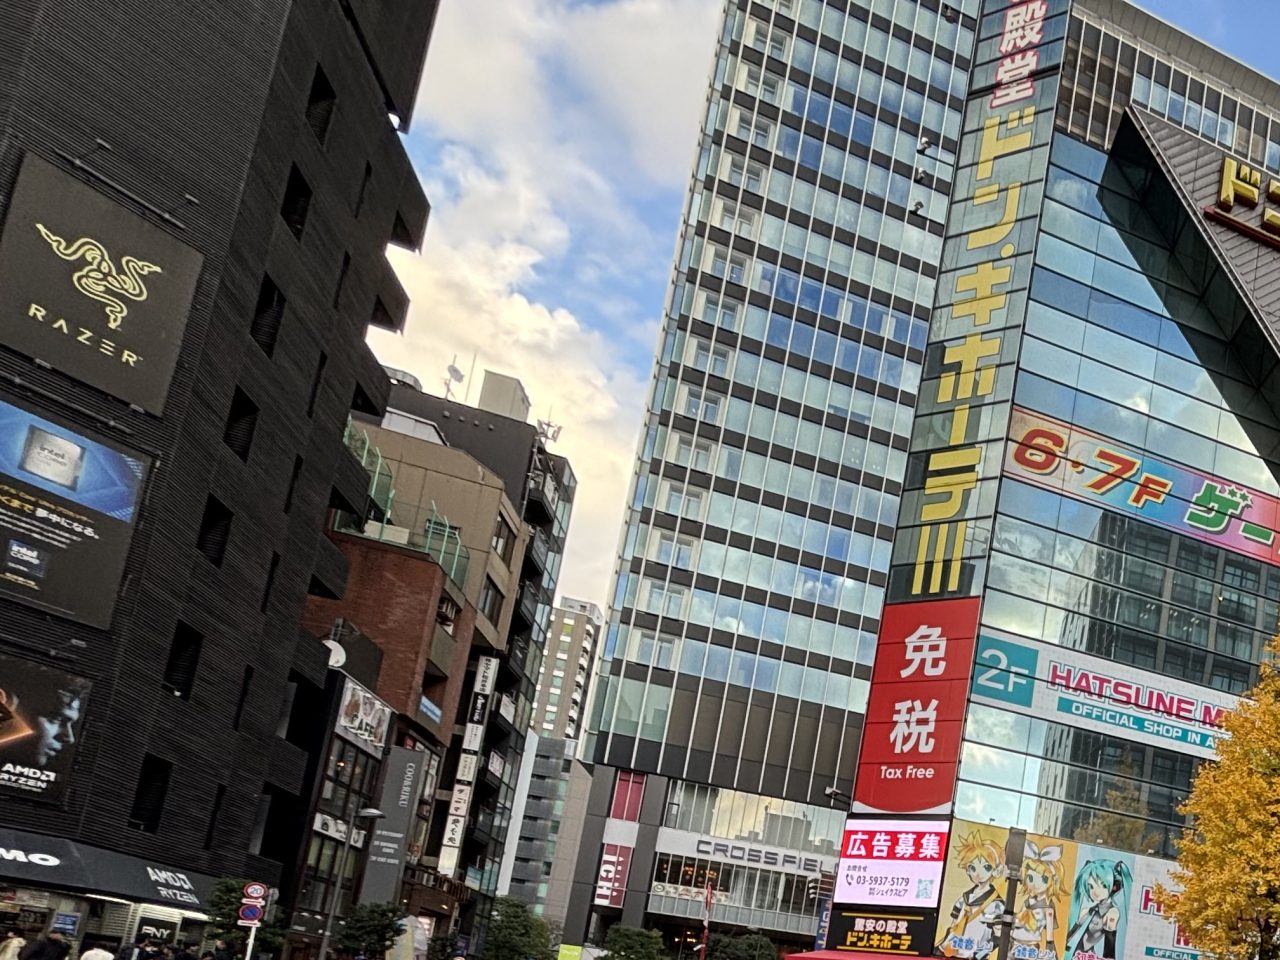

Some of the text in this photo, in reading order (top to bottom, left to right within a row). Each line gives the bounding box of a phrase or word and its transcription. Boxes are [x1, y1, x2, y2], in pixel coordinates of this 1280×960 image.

[28, 303, 142, 367] RAZER
[977, 649, 1029, 692] 2F
[890, 624, 947, 755] 免税
[1049, 663, 1196, 723] HATSUNE
[350, 712, 375, 739] CAFE
[1071, 704, 1138, 729] OFFICIAL
[1143, 722, 1182, 738] SHOP
[1187, 731, 1201, 743] IN
[1, 763, 46, 780] AMD
[880, 765, 935, 780] Tax Free
[846, 832, 941, 859] 広告募集
[147, 866, 187, 888] AMD
[856, 875, 910, 886] 03-5937-5179
[157, 886, 199, 904] RYZEN
[141, 925, 171, 940] PNY
[1152, 949, 1193, 960] OFFICIAL
